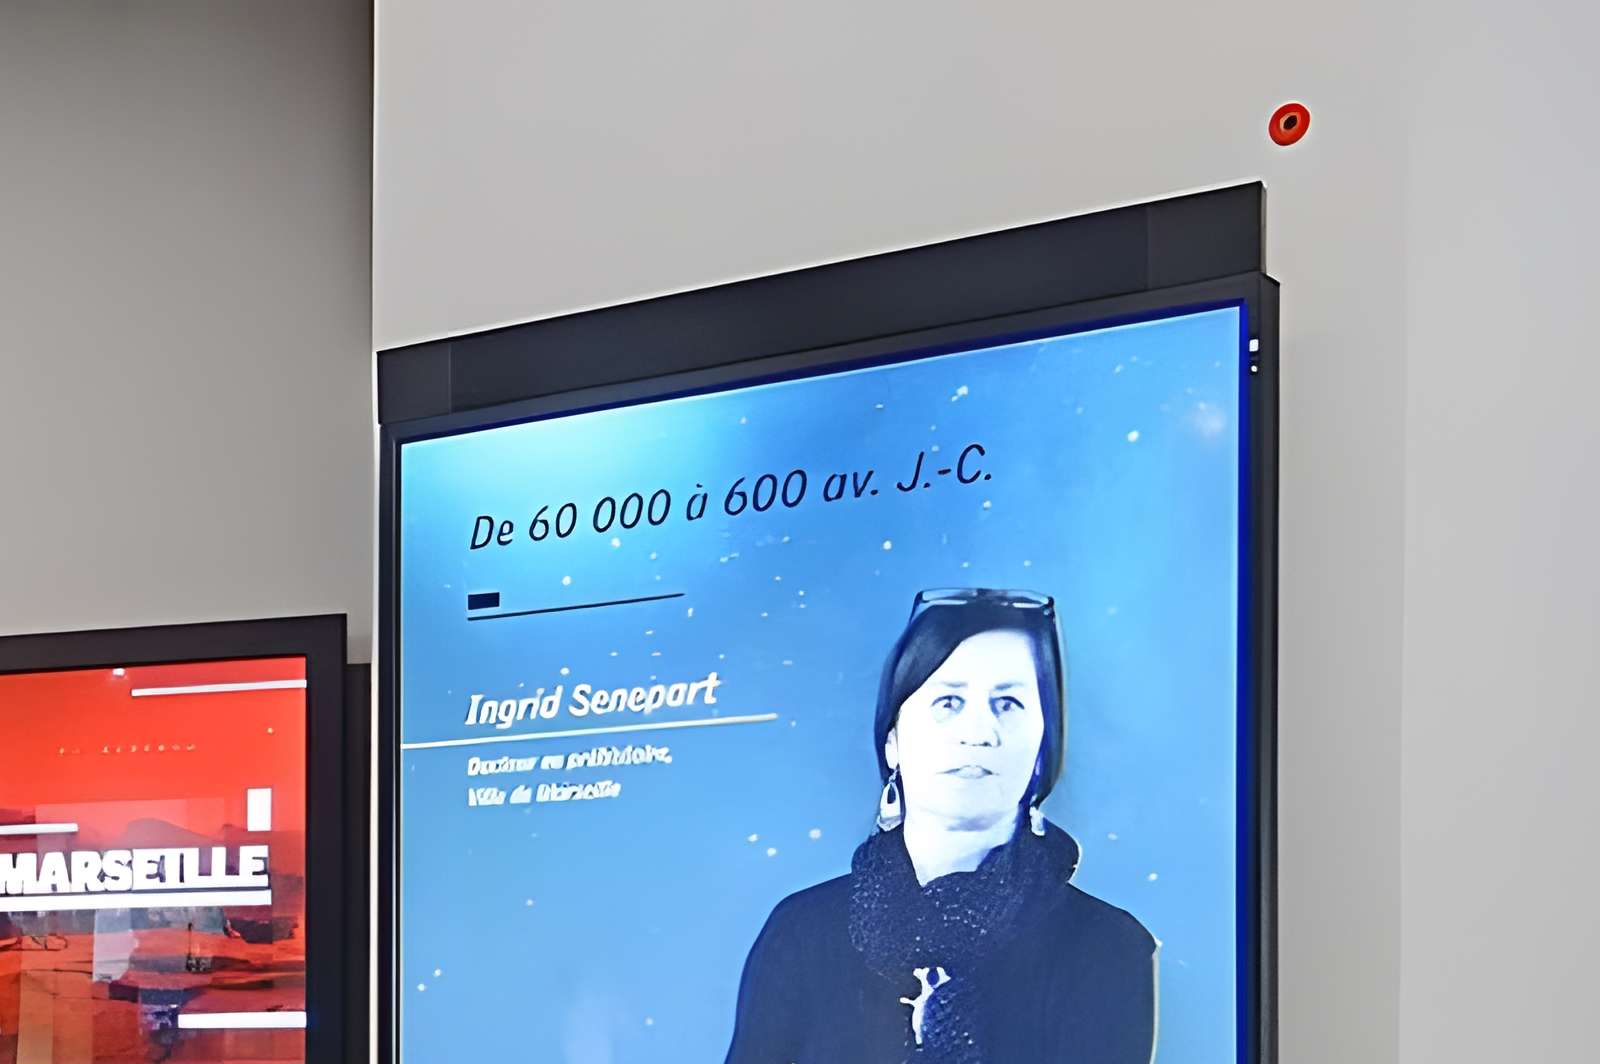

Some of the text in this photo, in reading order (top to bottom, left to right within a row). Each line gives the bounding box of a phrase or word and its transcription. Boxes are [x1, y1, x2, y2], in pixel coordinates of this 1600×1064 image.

[469, 443, 992, 551] De 60 000 à 600 av. J.-C.
[464, 671, 722, 730] Ingrid Senepart
